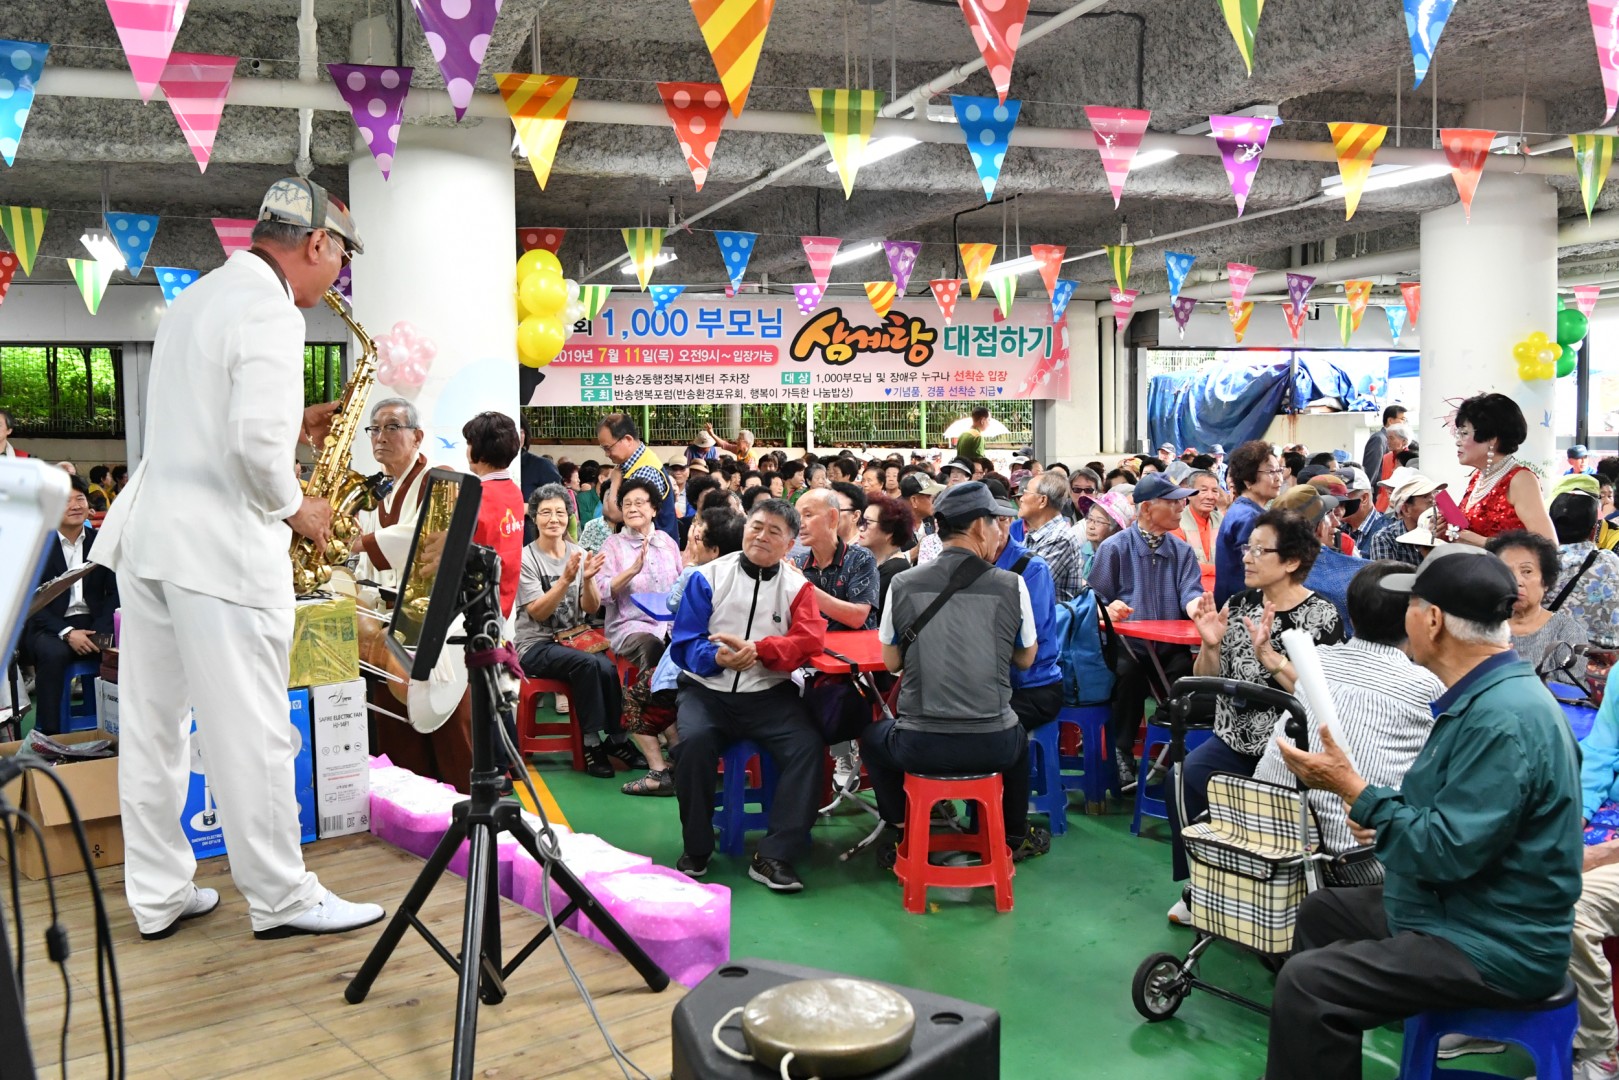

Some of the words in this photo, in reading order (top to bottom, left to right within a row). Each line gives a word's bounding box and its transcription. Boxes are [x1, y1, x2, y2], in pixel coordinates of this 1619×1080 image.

[602, 308, 688, 340] 1,000
[696, 308, 781, 338] 부모님
[944, 325, 1052, 358] 대접하기
[598, 347, 619, 363] 7월
[625, 347, 674, 363] 11일(목)
[614, 373, 714, 386] 반송2동행정복지센터
[719, 373, 750, 384] 주차장
[816, 373, 872, 384] 1,000부모님
[876, 372, 886, 382] 및
[890, 372, 918, 382] 장애우
[921, 371, 950, 382] 누구나
[954, 370, 985, 382] 선착순
[988, 370, 1007, 381] 입장
[750, 388, 778, 399] 행복이
[782, 388, 809, 398] 가득한
[813, 387, 853, 398] 나눔밥상)
[927, 387, 945, 397] 경품
[948, 386, 976, 397] 선착순
[980, 386, 996, 397] 지급
